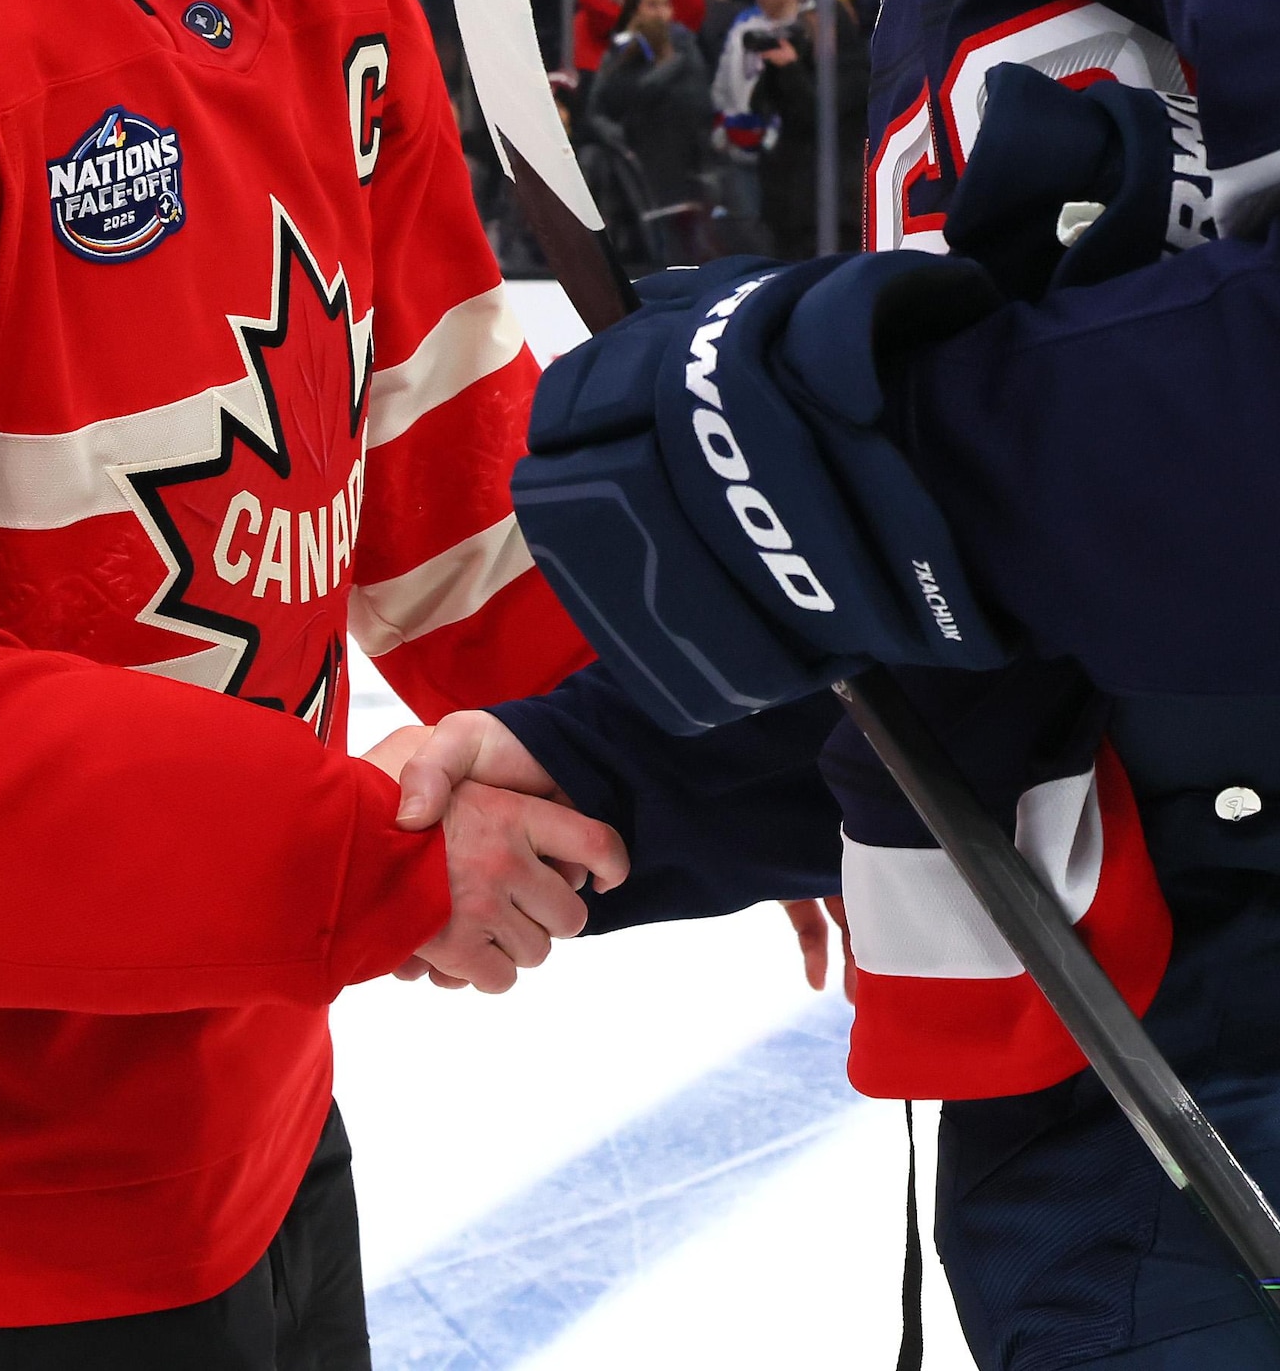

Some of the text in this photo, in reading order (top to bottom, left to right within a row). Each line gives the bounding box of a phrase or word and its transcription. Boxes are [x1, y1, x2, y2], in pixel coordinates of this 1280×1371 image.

[343, 32, 391, 187] C
[49, 133, 179, 200] NATIONS
[64, 167, 172, 222] FACE-OFF
[103, 210, 136, 232] 2025
[212, 416, 369, 604] CANAD
[911, 559, 963, 642] TKACHUK
